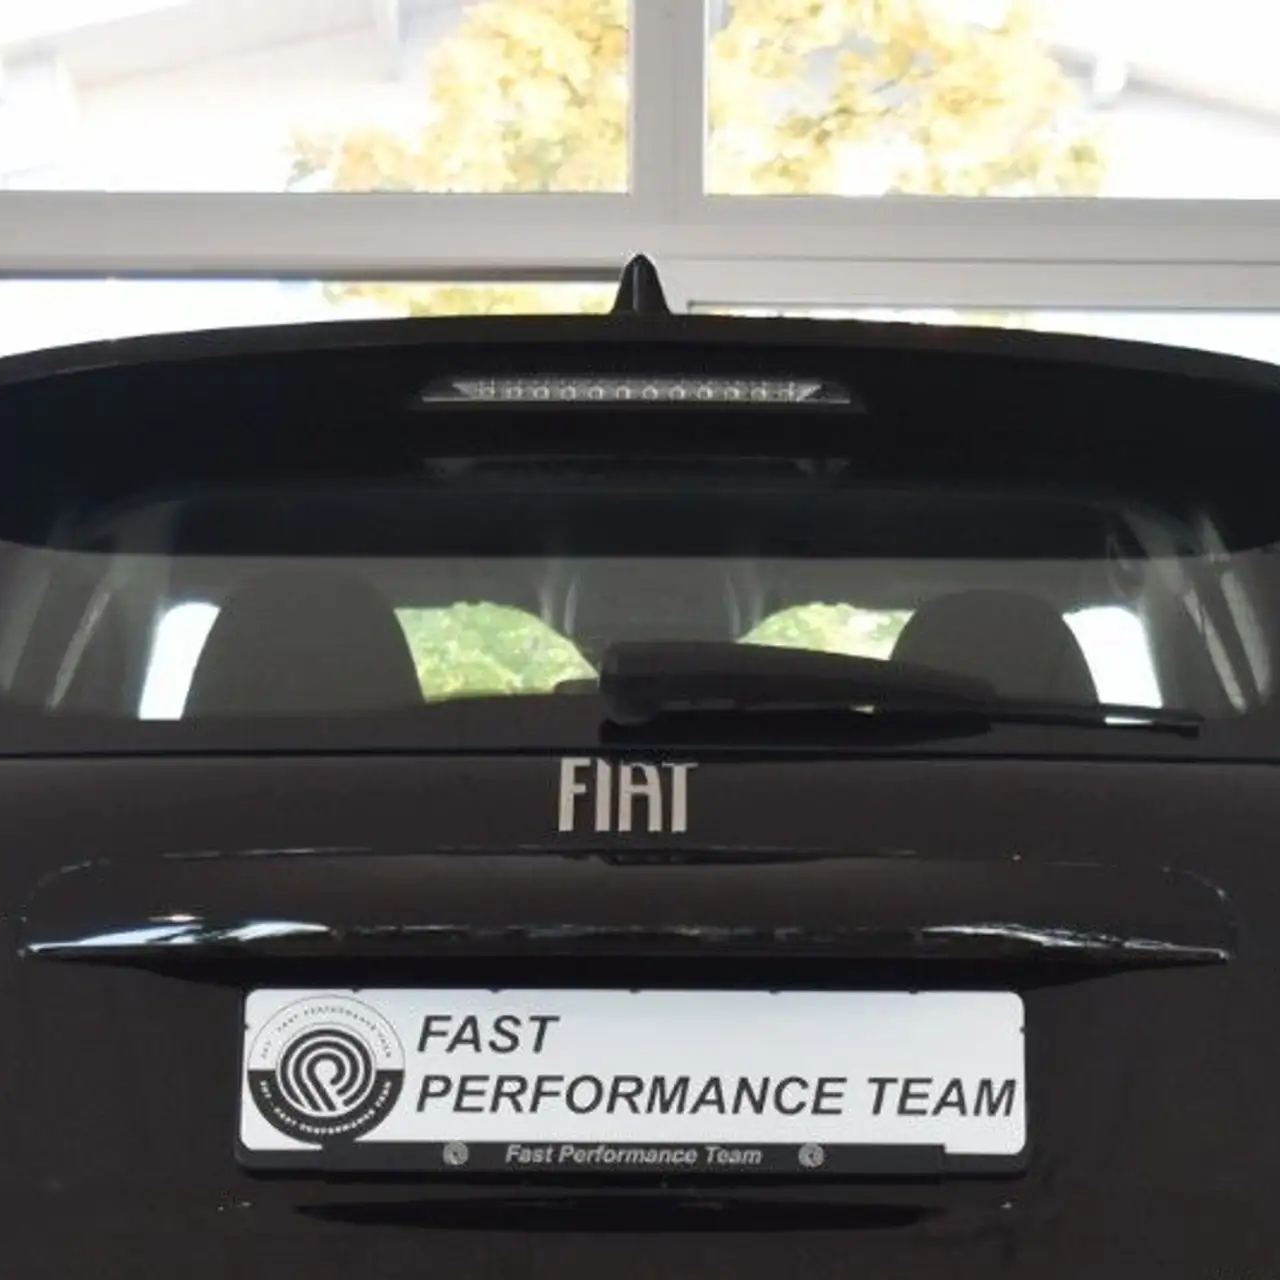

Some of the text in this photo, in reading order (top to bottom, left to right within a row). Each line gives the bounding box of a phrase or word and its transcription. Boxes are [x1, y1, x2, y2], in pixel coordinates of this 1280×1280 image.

[558, 757, 698, 832] FIAT
[416, 1014, 561, 1054] FAST
[416, 1074, 848, 1116] PERFORMANCE
[867, 1076, 1017, 1117] TEAM
[505, 1143, 762, 1165] Fast Performance Team
